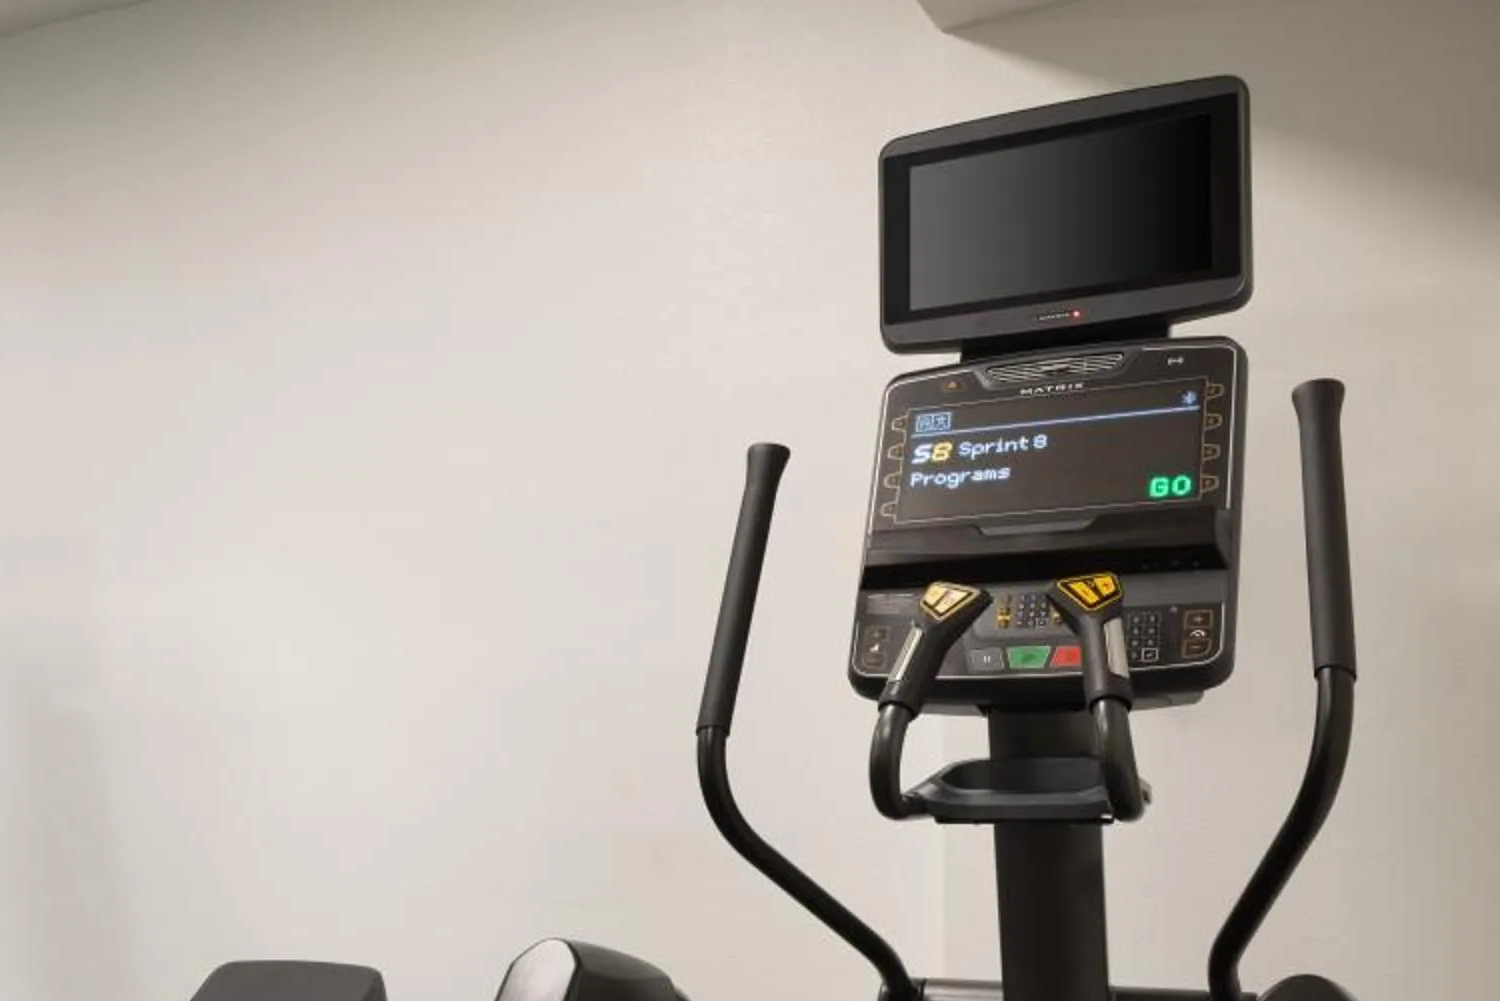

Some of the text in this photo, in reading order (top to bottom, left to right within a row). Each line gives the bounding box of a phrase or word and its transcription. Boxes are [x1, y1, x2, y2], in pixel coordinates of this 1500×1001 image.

[1019, 382, 1084, 396] MATRIX
[911, 433, 1048, 465] S8 Sprint 8
[909, 467, 1012, 489] Programs
[1150, 475, 1191, 497] GO
